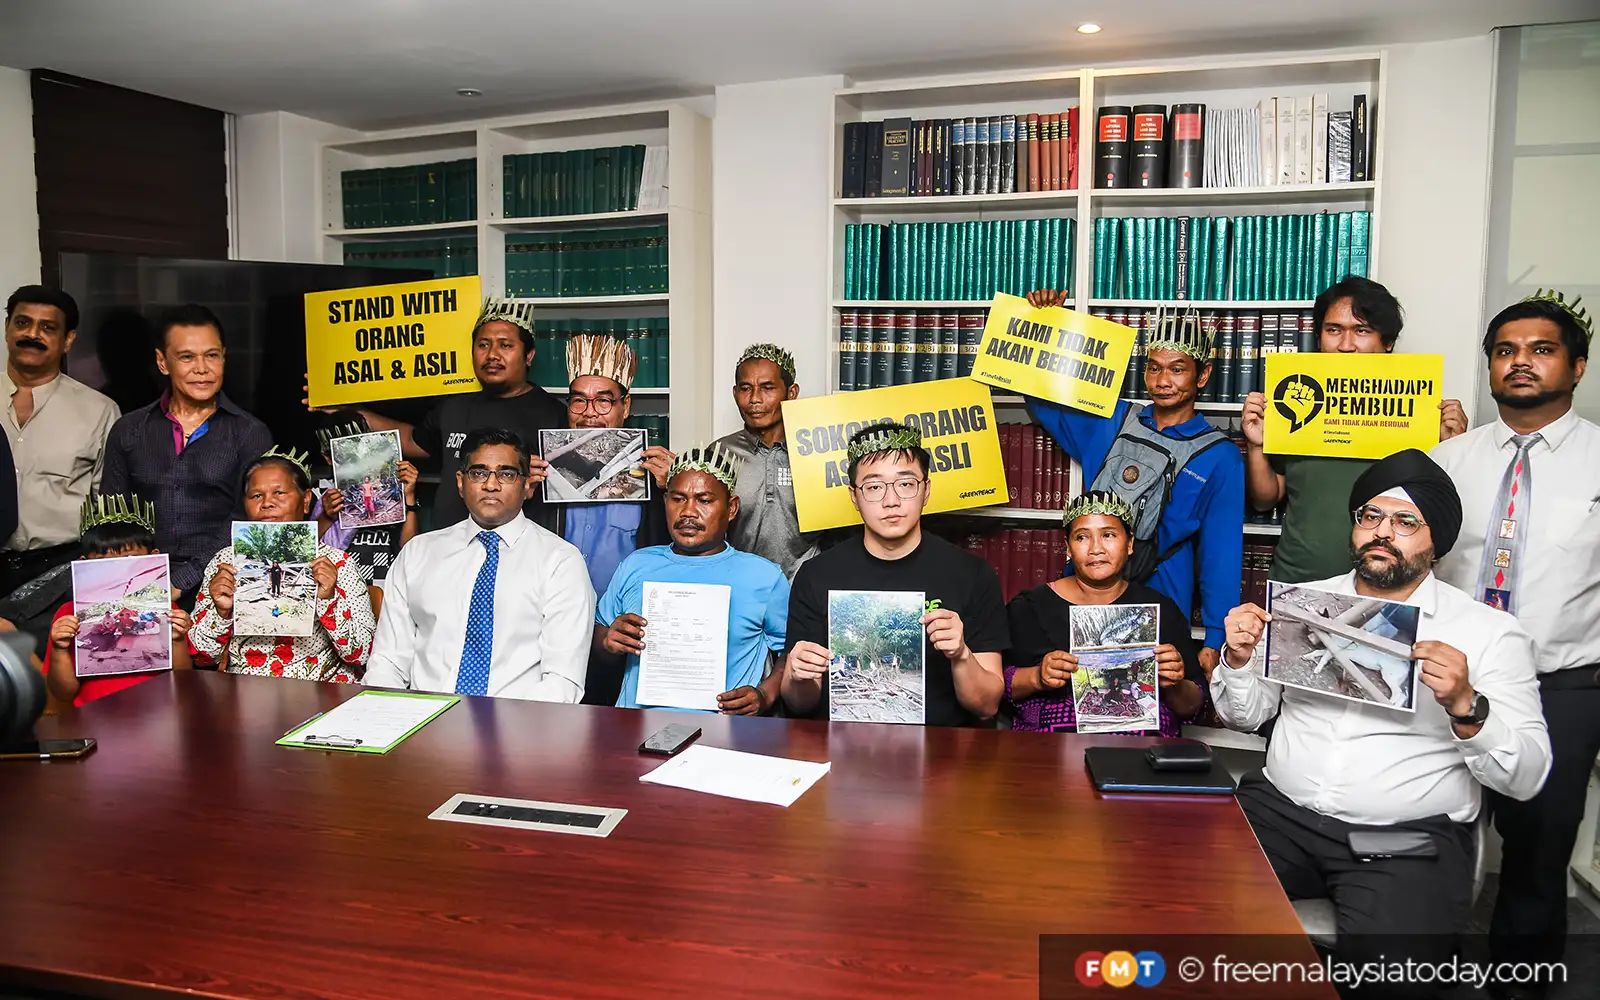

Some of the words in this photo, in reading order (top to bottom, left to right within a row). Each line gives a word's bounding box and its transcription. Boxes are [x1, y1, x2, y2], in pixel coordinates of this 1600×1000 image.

[328, 295, 394, 324] STAND
[401, 289, 457, 316] WITH
[355, 323, 425, 352] ORANG
[1006, 317, 1053, 344] KAMI
[1056, 328, 1110, 360] TIDAK
[334, 358, 384, 385] ASAL
[390, 359, 406, 380] &
[413, 351, 457, 377] ASLI
[985, 337, 1034, 365] AKAN
[1036, 349, 1116, 388] BERDIAM
[442, 377, 476, 386] GREENPEACE
[1326, 378, 1433, 396] MENGHADAPI
[1325, 396, 1414, 417] PEMBULI
[959, 487, 997, 499] GREENPEACE
